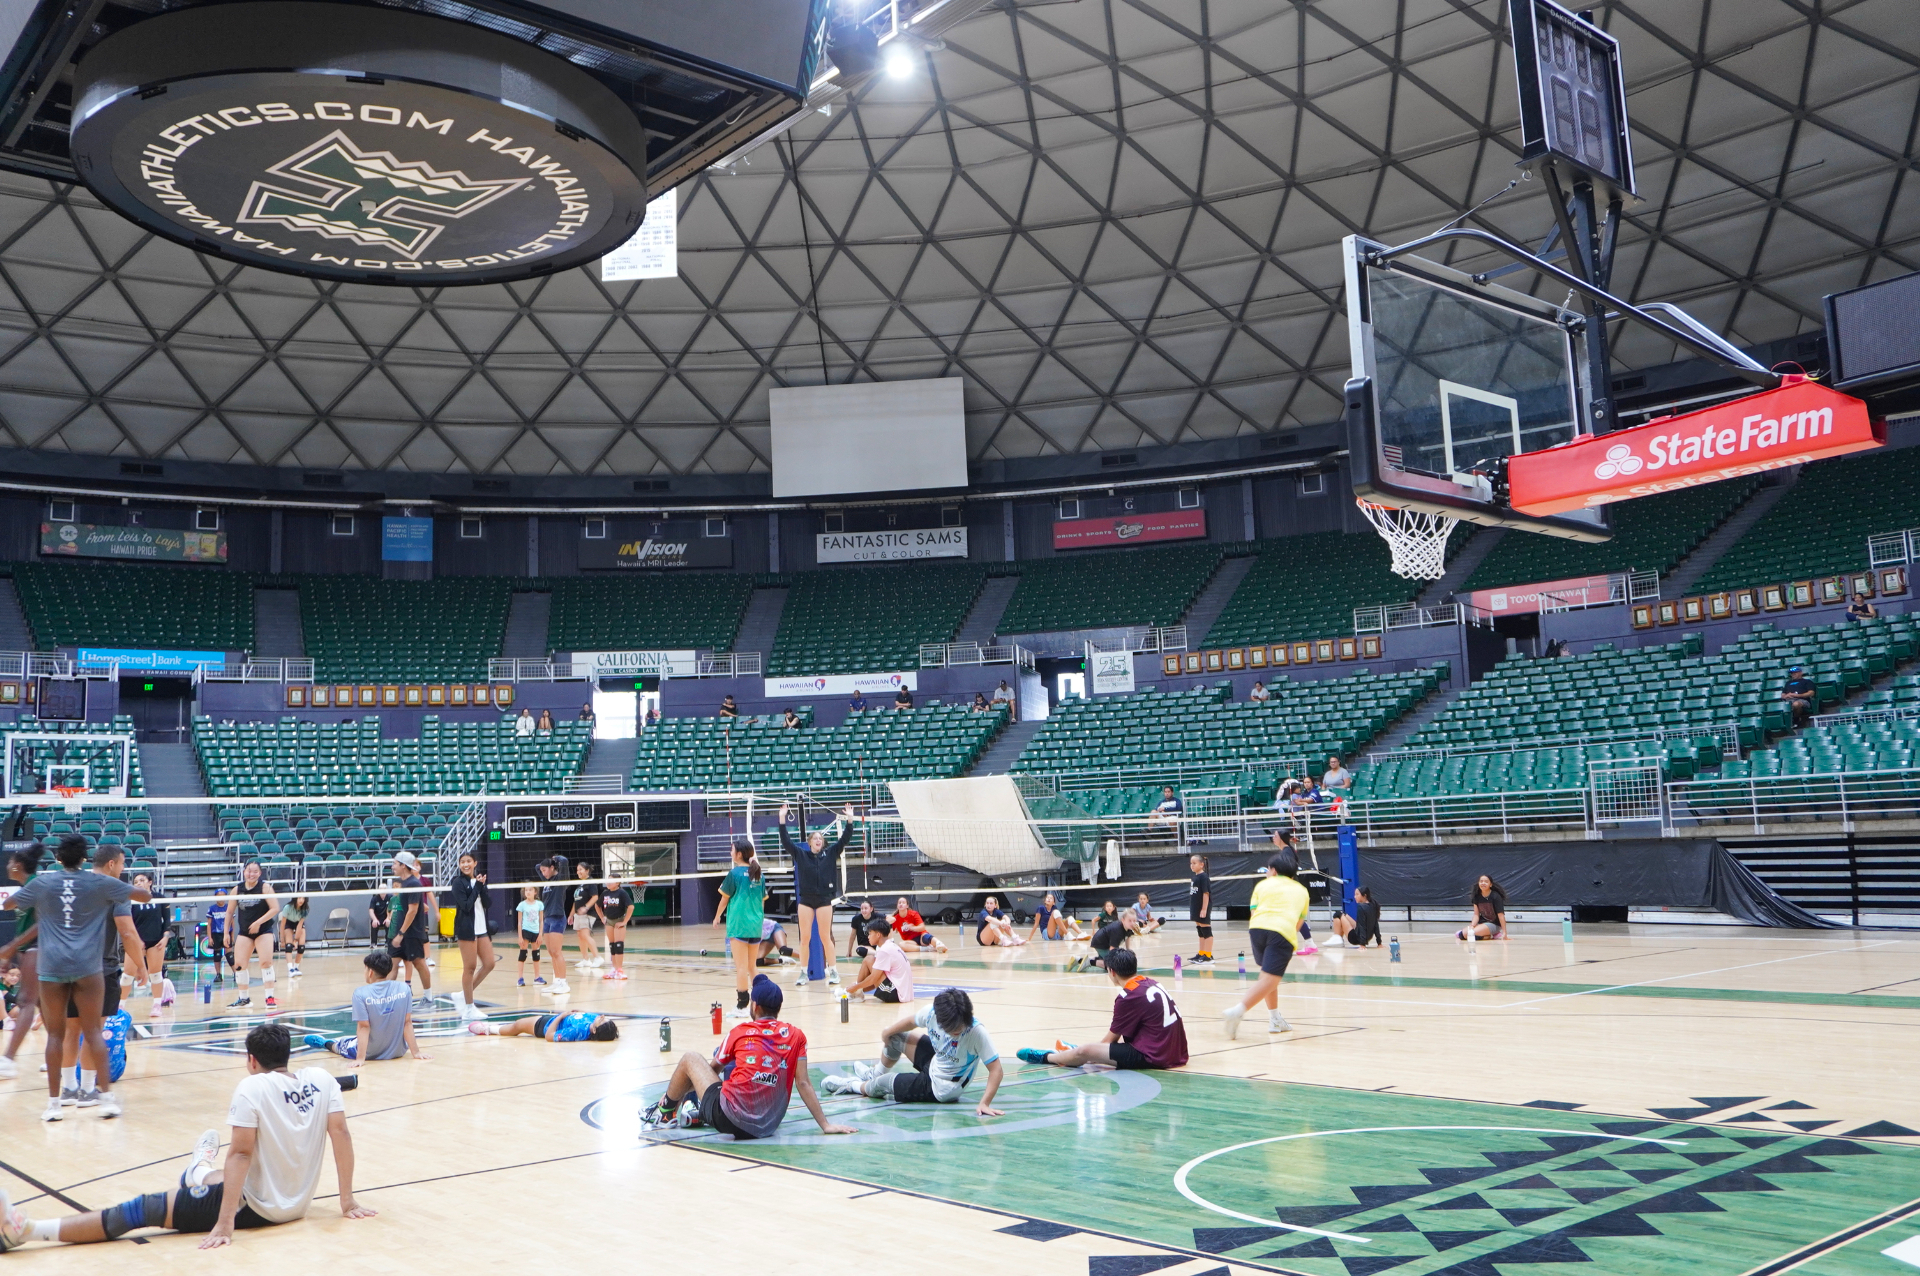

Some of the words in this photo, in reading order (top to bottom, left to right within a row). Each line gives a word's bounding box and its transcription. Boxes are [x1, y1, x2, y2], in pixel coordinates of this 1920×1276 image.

[1550, 9, 1593, 39] DAKTRONICS
[1125, 500, 1134, 510] G
[404, 507, 412, 517] K
[132, 514, 139, 524] L
[888, 516, 896, 526] H
[85, 531, 115, 544] From
[117, 531, 140, 543] Leis
[142, 533, 153, 544] to
[822, 533, 909, 549] FANTASTIC
[916, 530, 962, 546] SAMS
[137, 545, 157, 556] PRIDE
[853, 551, 877, 560] CUT
[880, 551, 887, 559] &
[892, 549, 931, 558] COLOR
[597, 652, 670, 666] CALIFORNIA
[779, 682, 814, 690] HAWAIIAN
[556, 824, 575, 832] PERIOD
[490, 831, 501, 840] EXIT
[365, 991, 407, 1005] Champions
